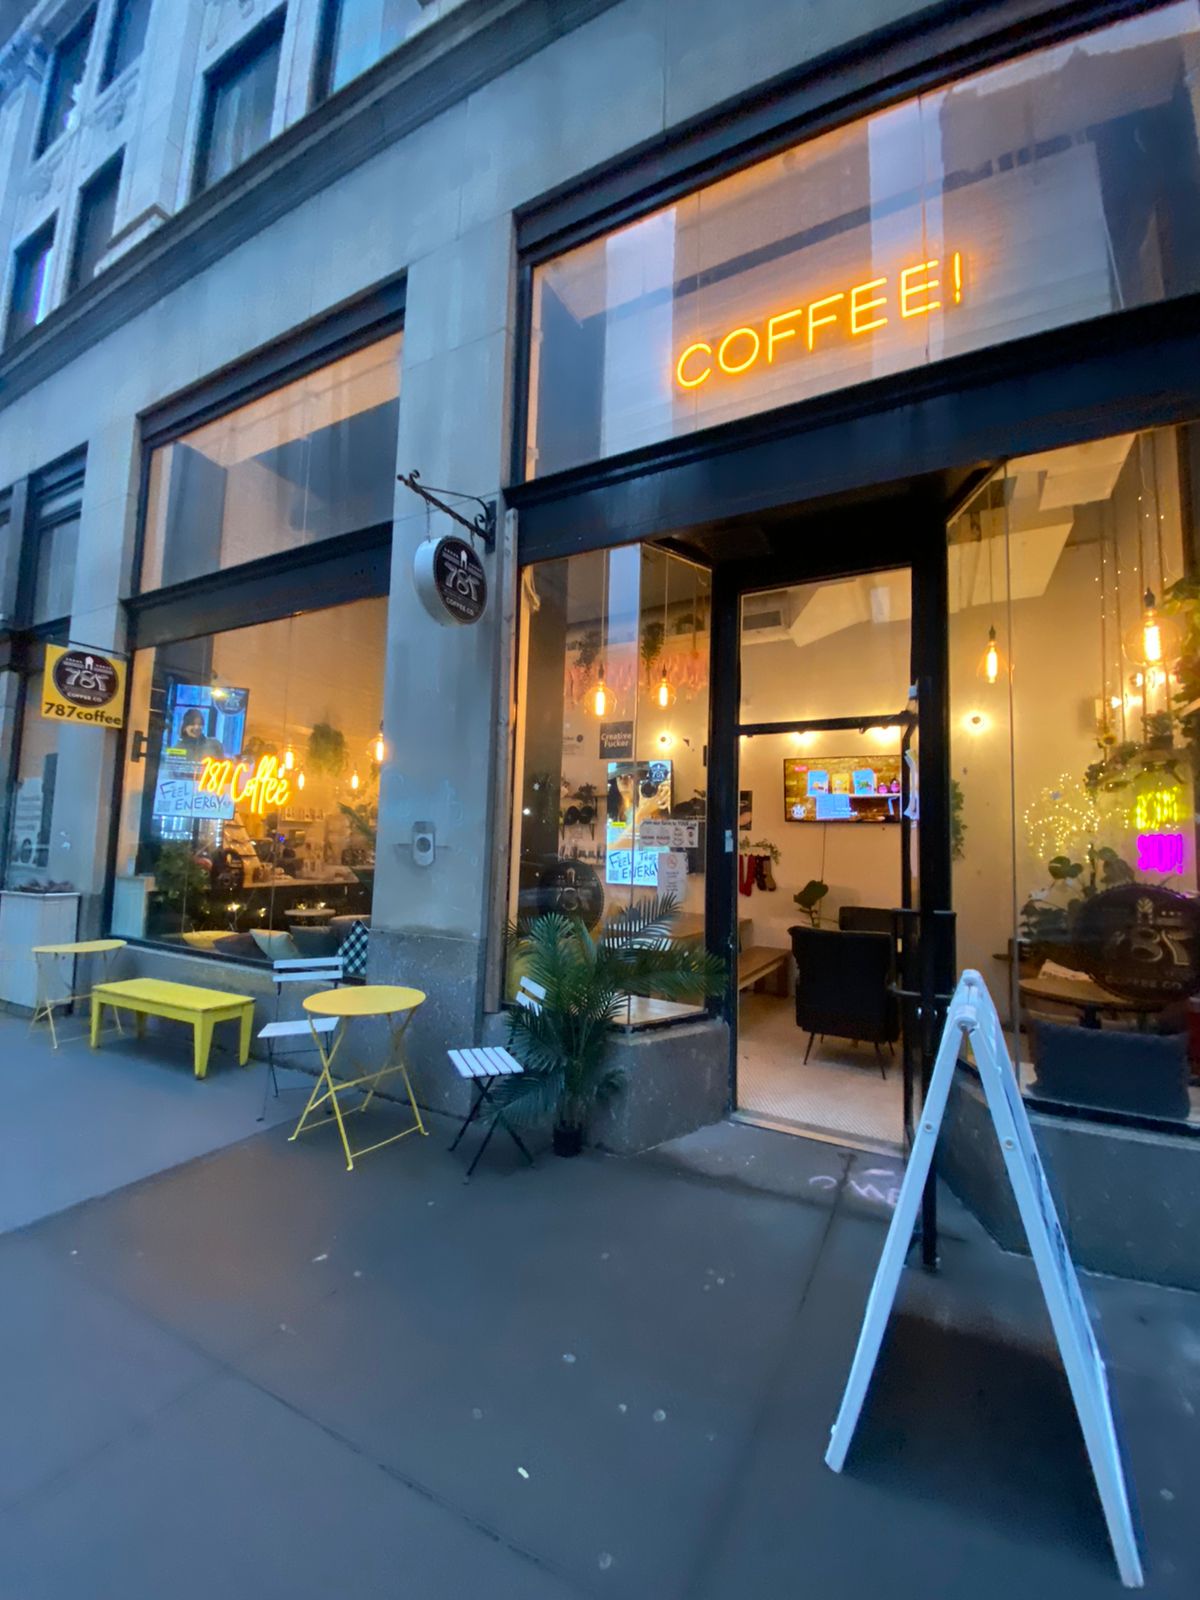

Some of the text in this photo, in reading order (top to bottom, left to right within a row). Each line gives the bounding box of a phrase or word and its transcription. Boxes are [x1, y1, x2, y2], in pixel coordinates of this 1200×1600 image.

[676, 251, 961, 389] COFFEE!
[444, 561, 480, 601] 787
[64, 667, 109, 691] 787
[44, 702, 122, 724] 787coffee
[198, 756, 232, 796] 787
[231, 755, 290, 815] Coffee
[175, 796, 224, 812] ENERGY
